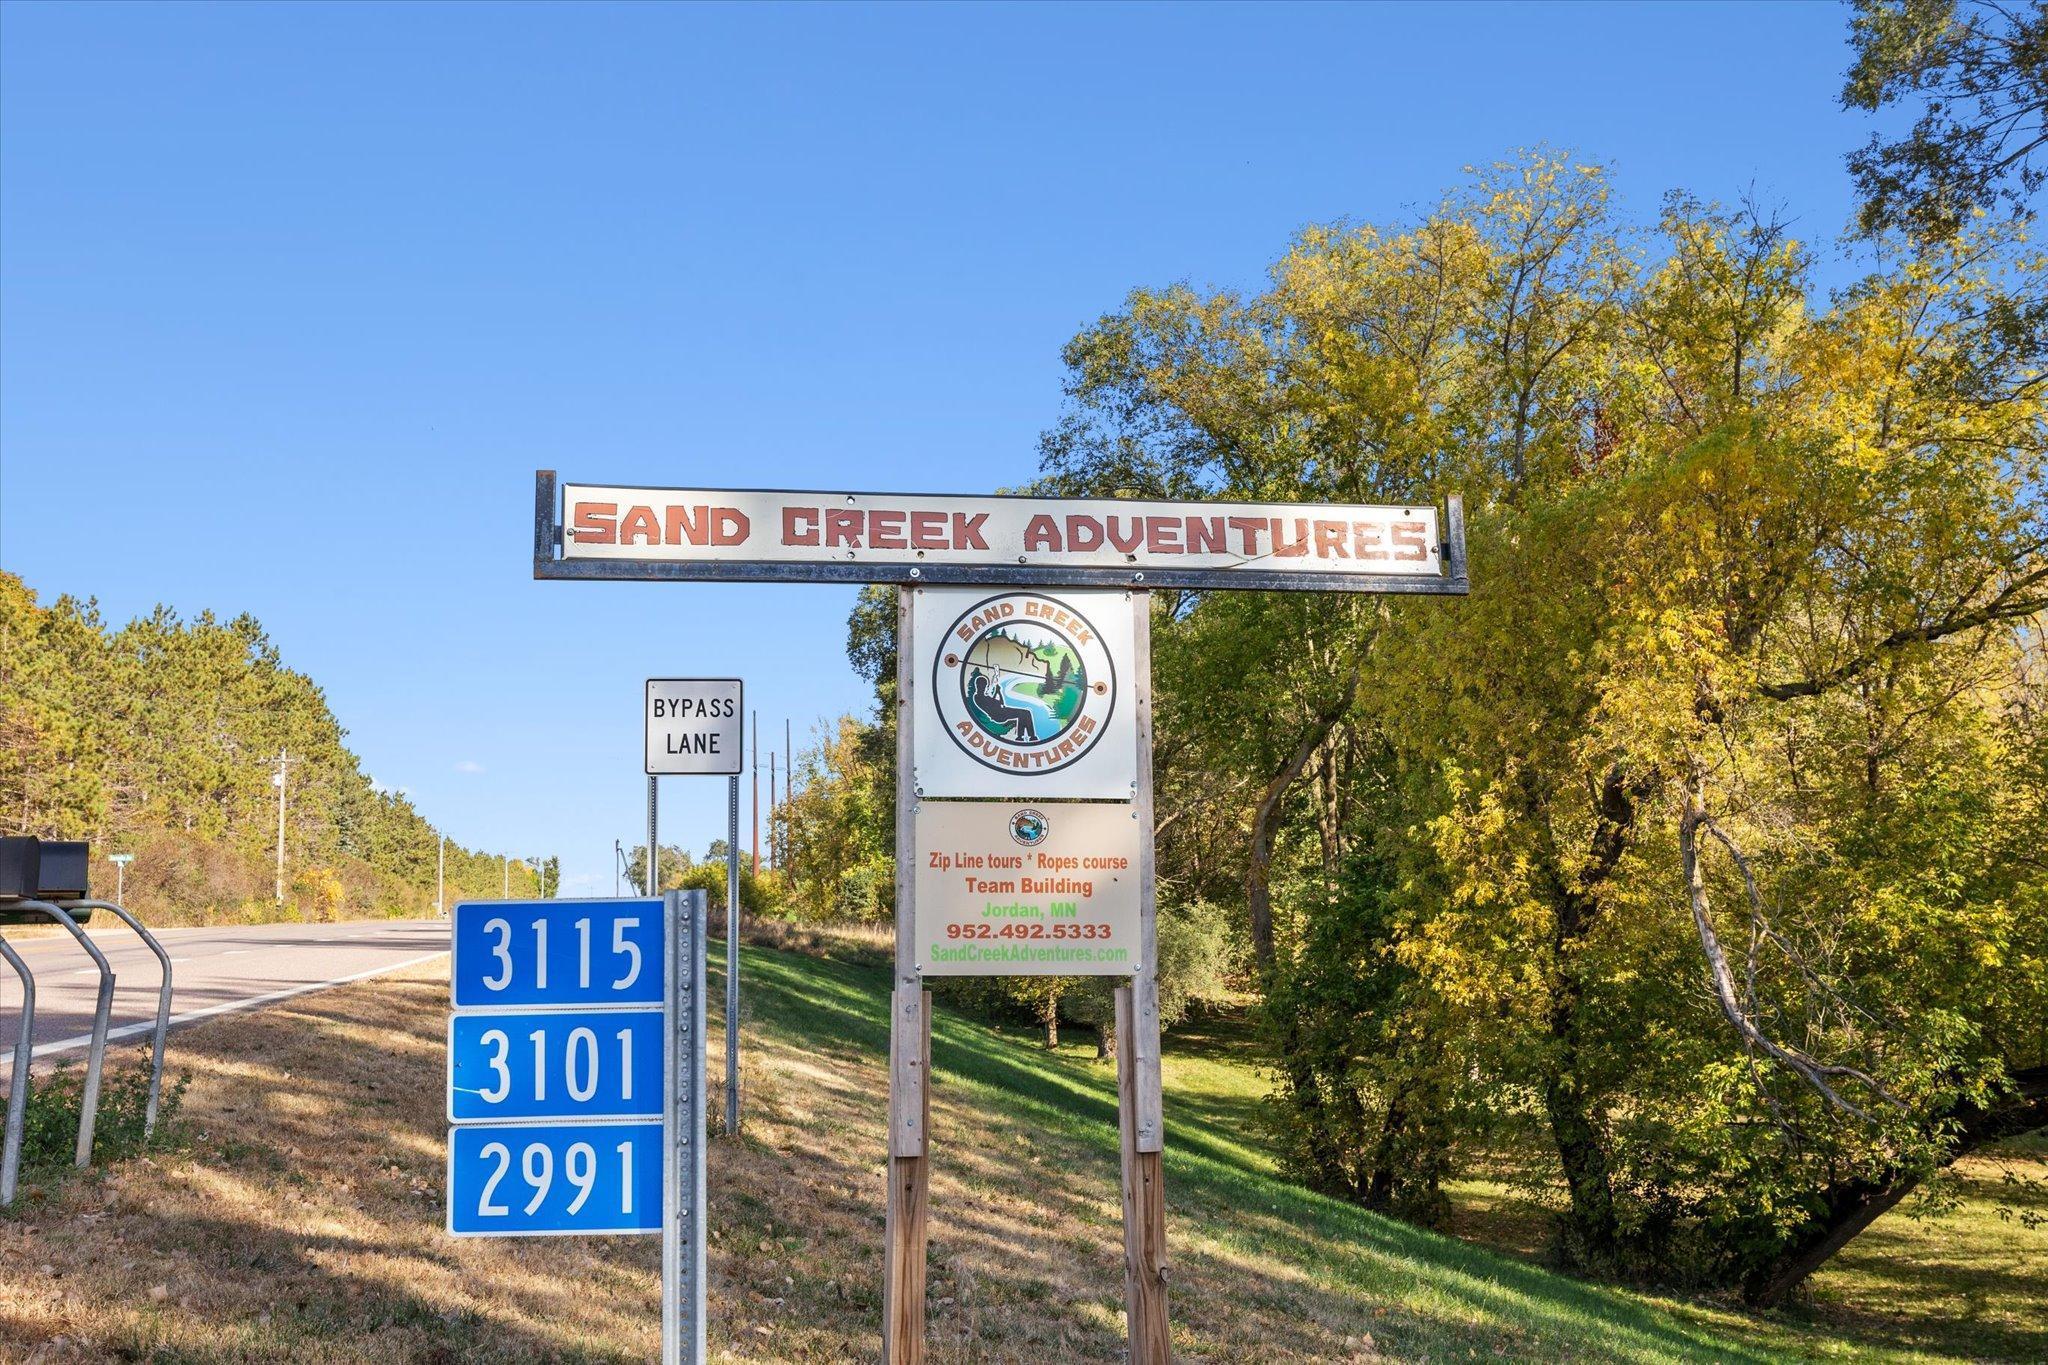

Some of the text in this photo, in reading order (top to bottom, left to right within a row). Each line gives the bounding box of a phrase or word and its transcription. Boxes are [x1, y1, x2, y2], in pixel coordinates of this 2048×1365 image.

[574, 502, 1427, 561] SAND CREEK ADVENTURES
[956, 601, 1094, 647] SAND CREEK
[654, 698, 734, 718] BYPASS
[667, 733, 720, 754] LANE
[956, 714, 1097, 768] ADVENTURES
[929, 852, 951, 872] Zip
[955, 852, 984, 868] Line
[988, 853, 1022, 869] tours
[1037, 853, 1079, 872] Ropes
[1082, 856, 1128, 870] course
[965, 877, 1093, 897] Team Building
[981, 902, 1077, 920] Jordan, MN
[946, 924, 1112, 939] 952.492.5333
[482, 917, 642, 991] 3115
[930, 944, 1127, 962] SandCreekAdventures.com
[479, 1026, 633, 1104] 3101
[477, 1141, 633, 1217] 2991
